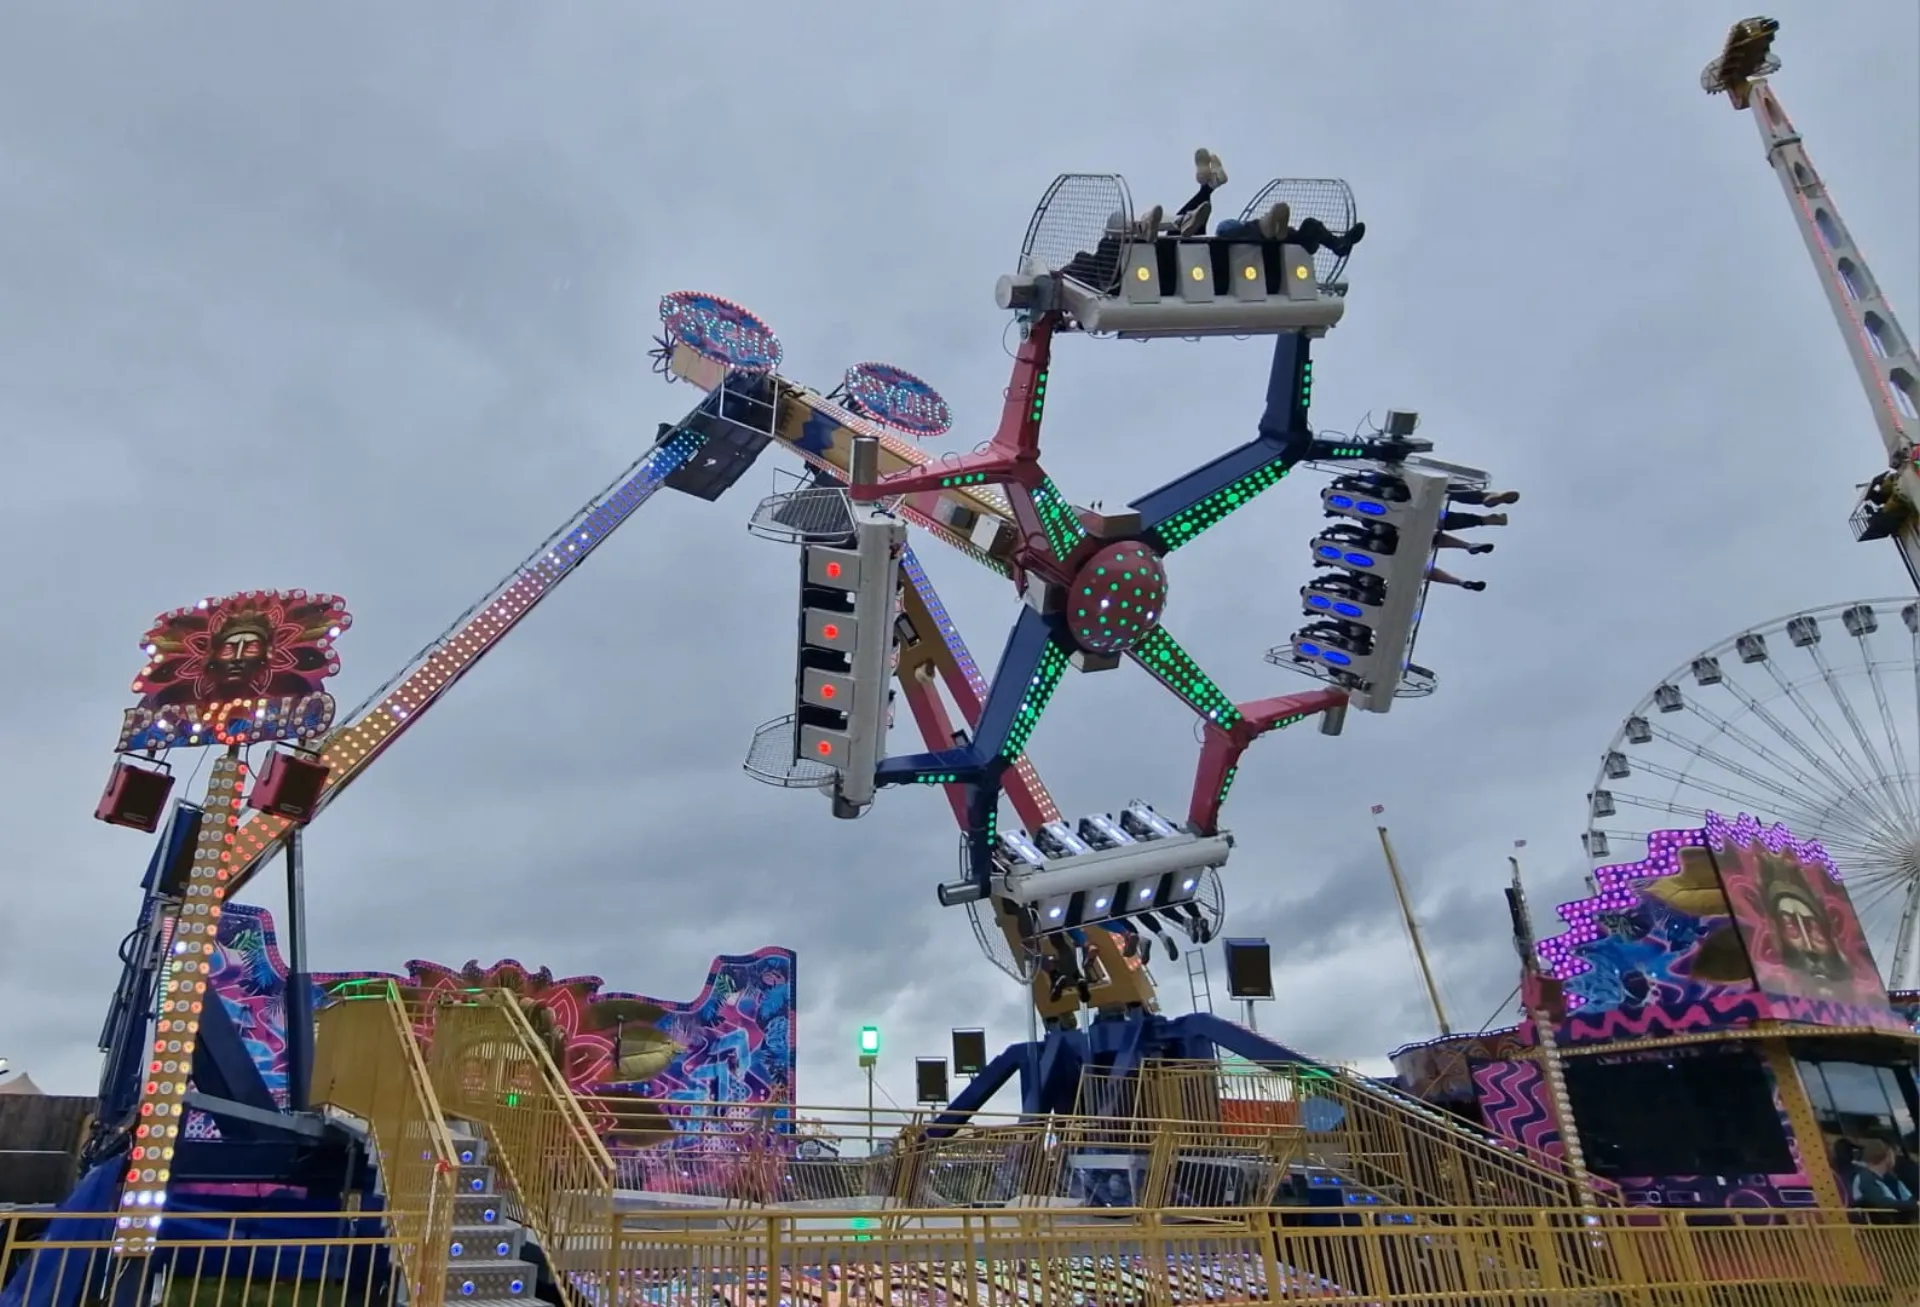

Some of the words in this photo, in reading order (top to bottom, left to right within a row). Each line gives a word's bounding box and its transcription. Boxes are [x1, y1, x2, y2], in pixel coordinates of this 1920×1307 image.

[661, 296, 783, 367] PSYCHO
[848, 366, 953, 428] PSYCHO
[118, 691, 333, 748] PSYCHO
